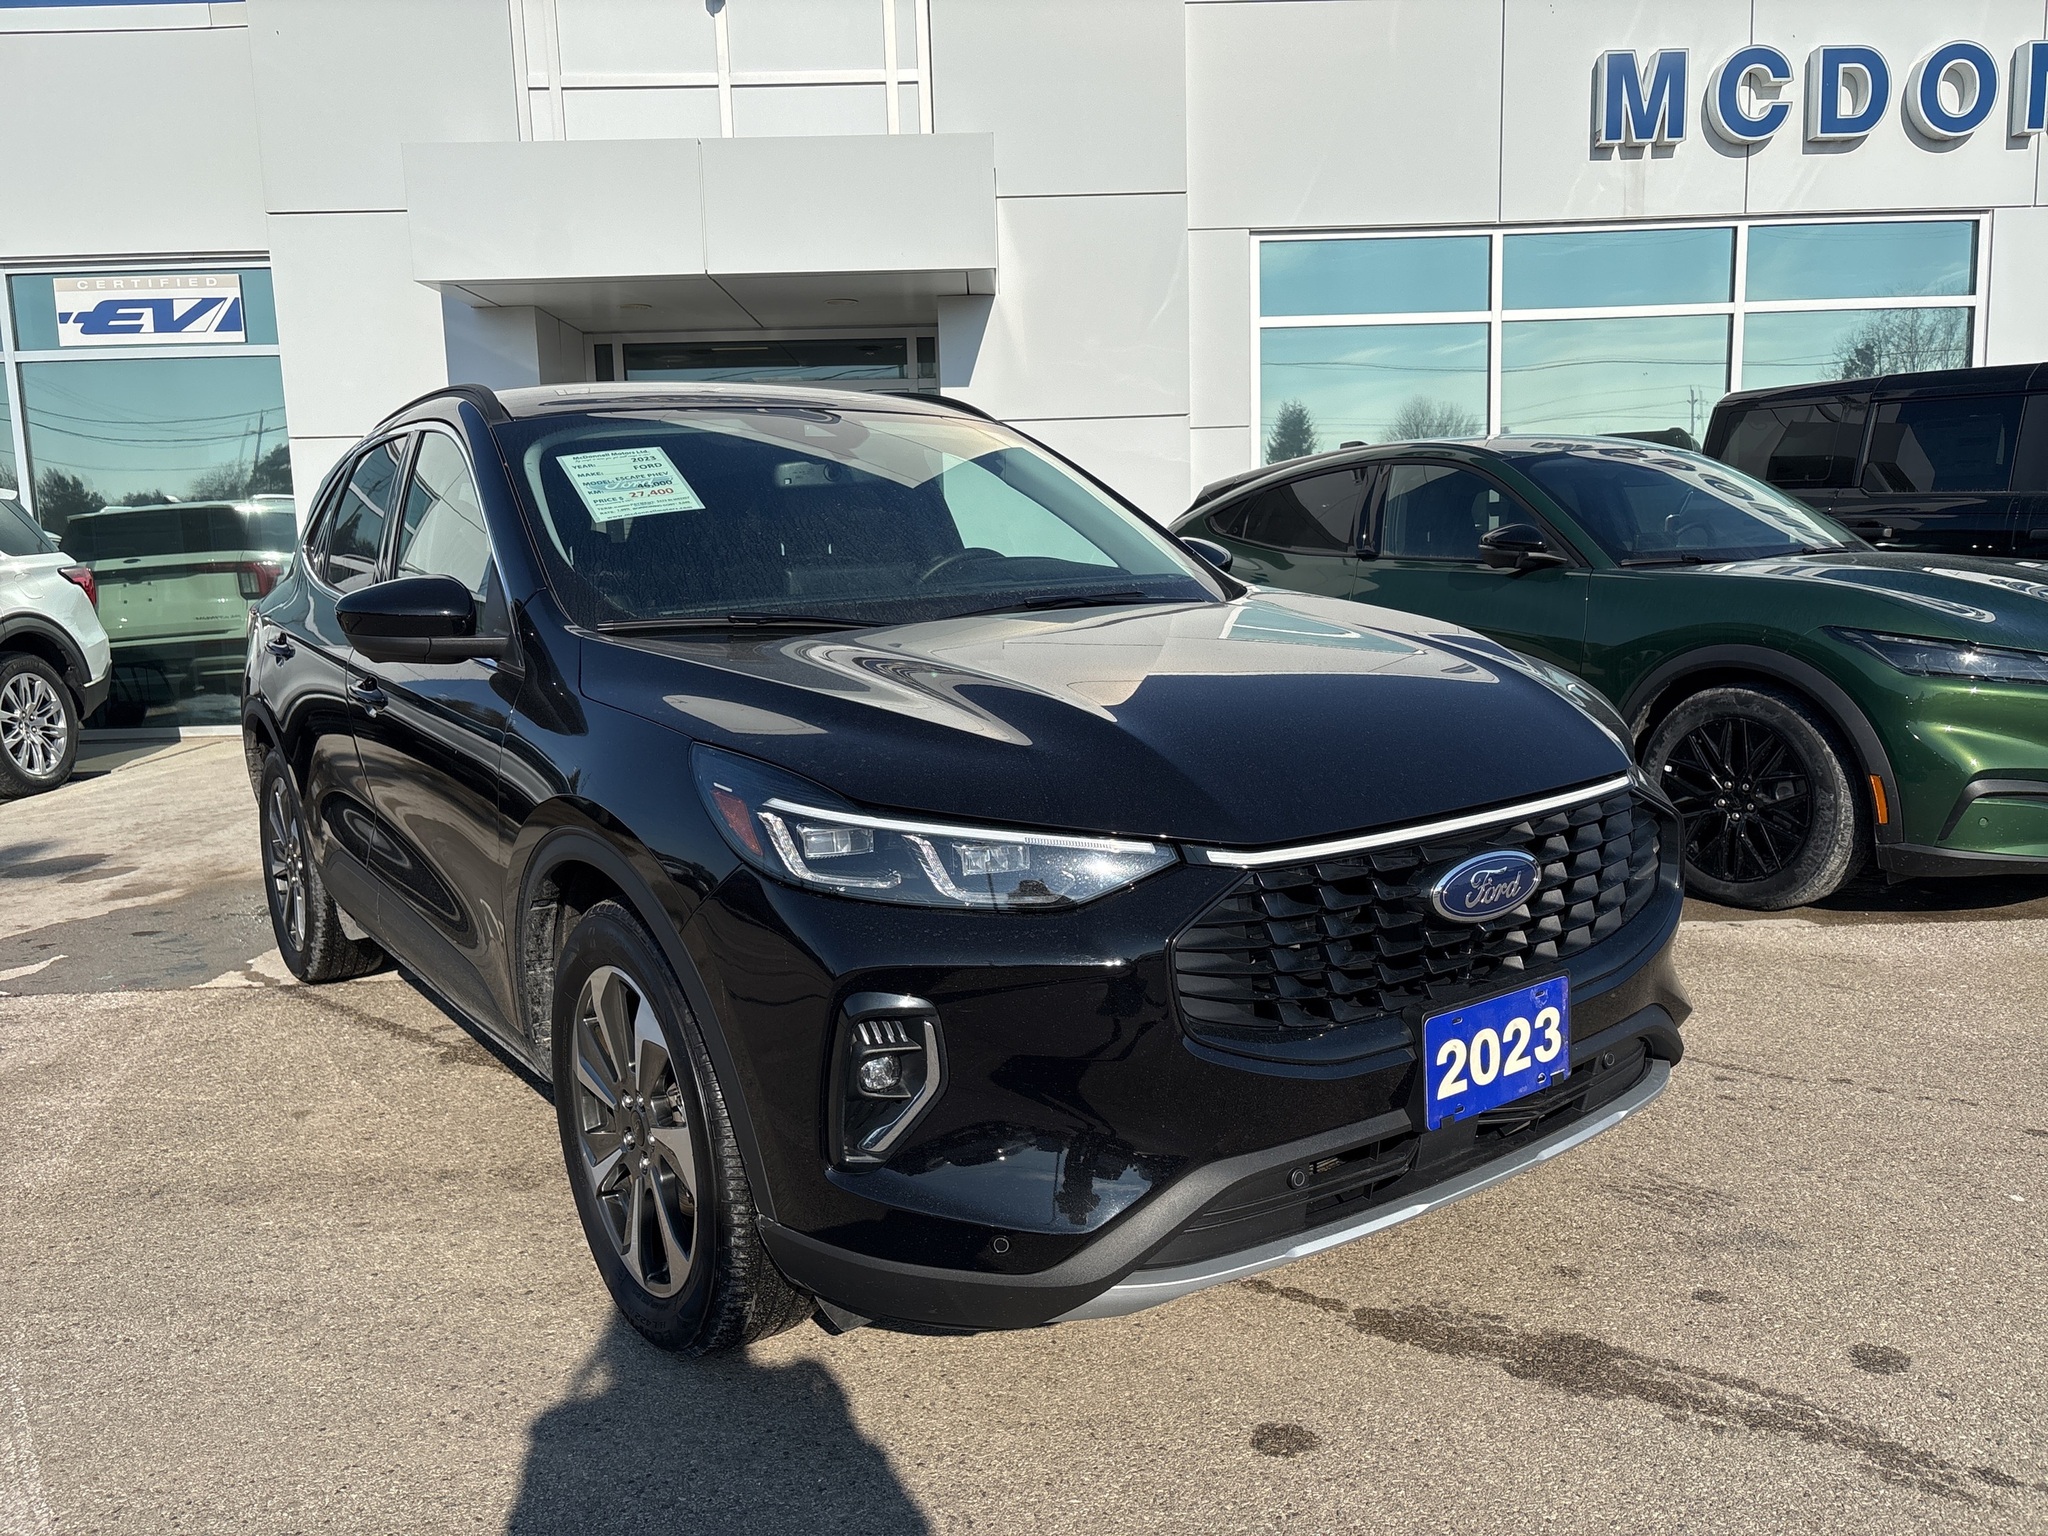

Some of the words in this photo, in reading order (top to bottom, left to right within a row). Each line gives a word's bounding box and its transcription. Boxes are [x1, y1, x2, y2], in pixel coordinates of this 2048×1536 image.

[1598, 40, 2048, 146] MCDO
[77, 276, 218, 290] CERTIFIED
[631, 455, 657, 463] 2023
[633, 462, 663, 470] FORD
[582, 479, 616, 487] MODEL:
[615, 473, 646, 481] ESCAPE
[637, 479, 673, 488] 46,000
[593, 496, 617, 504] PRICE
[628, 487, 675, 498] 27,400
[1464, 865, 1522, 910] Ford
[1436, 1006, 1563, 1101] 2023
